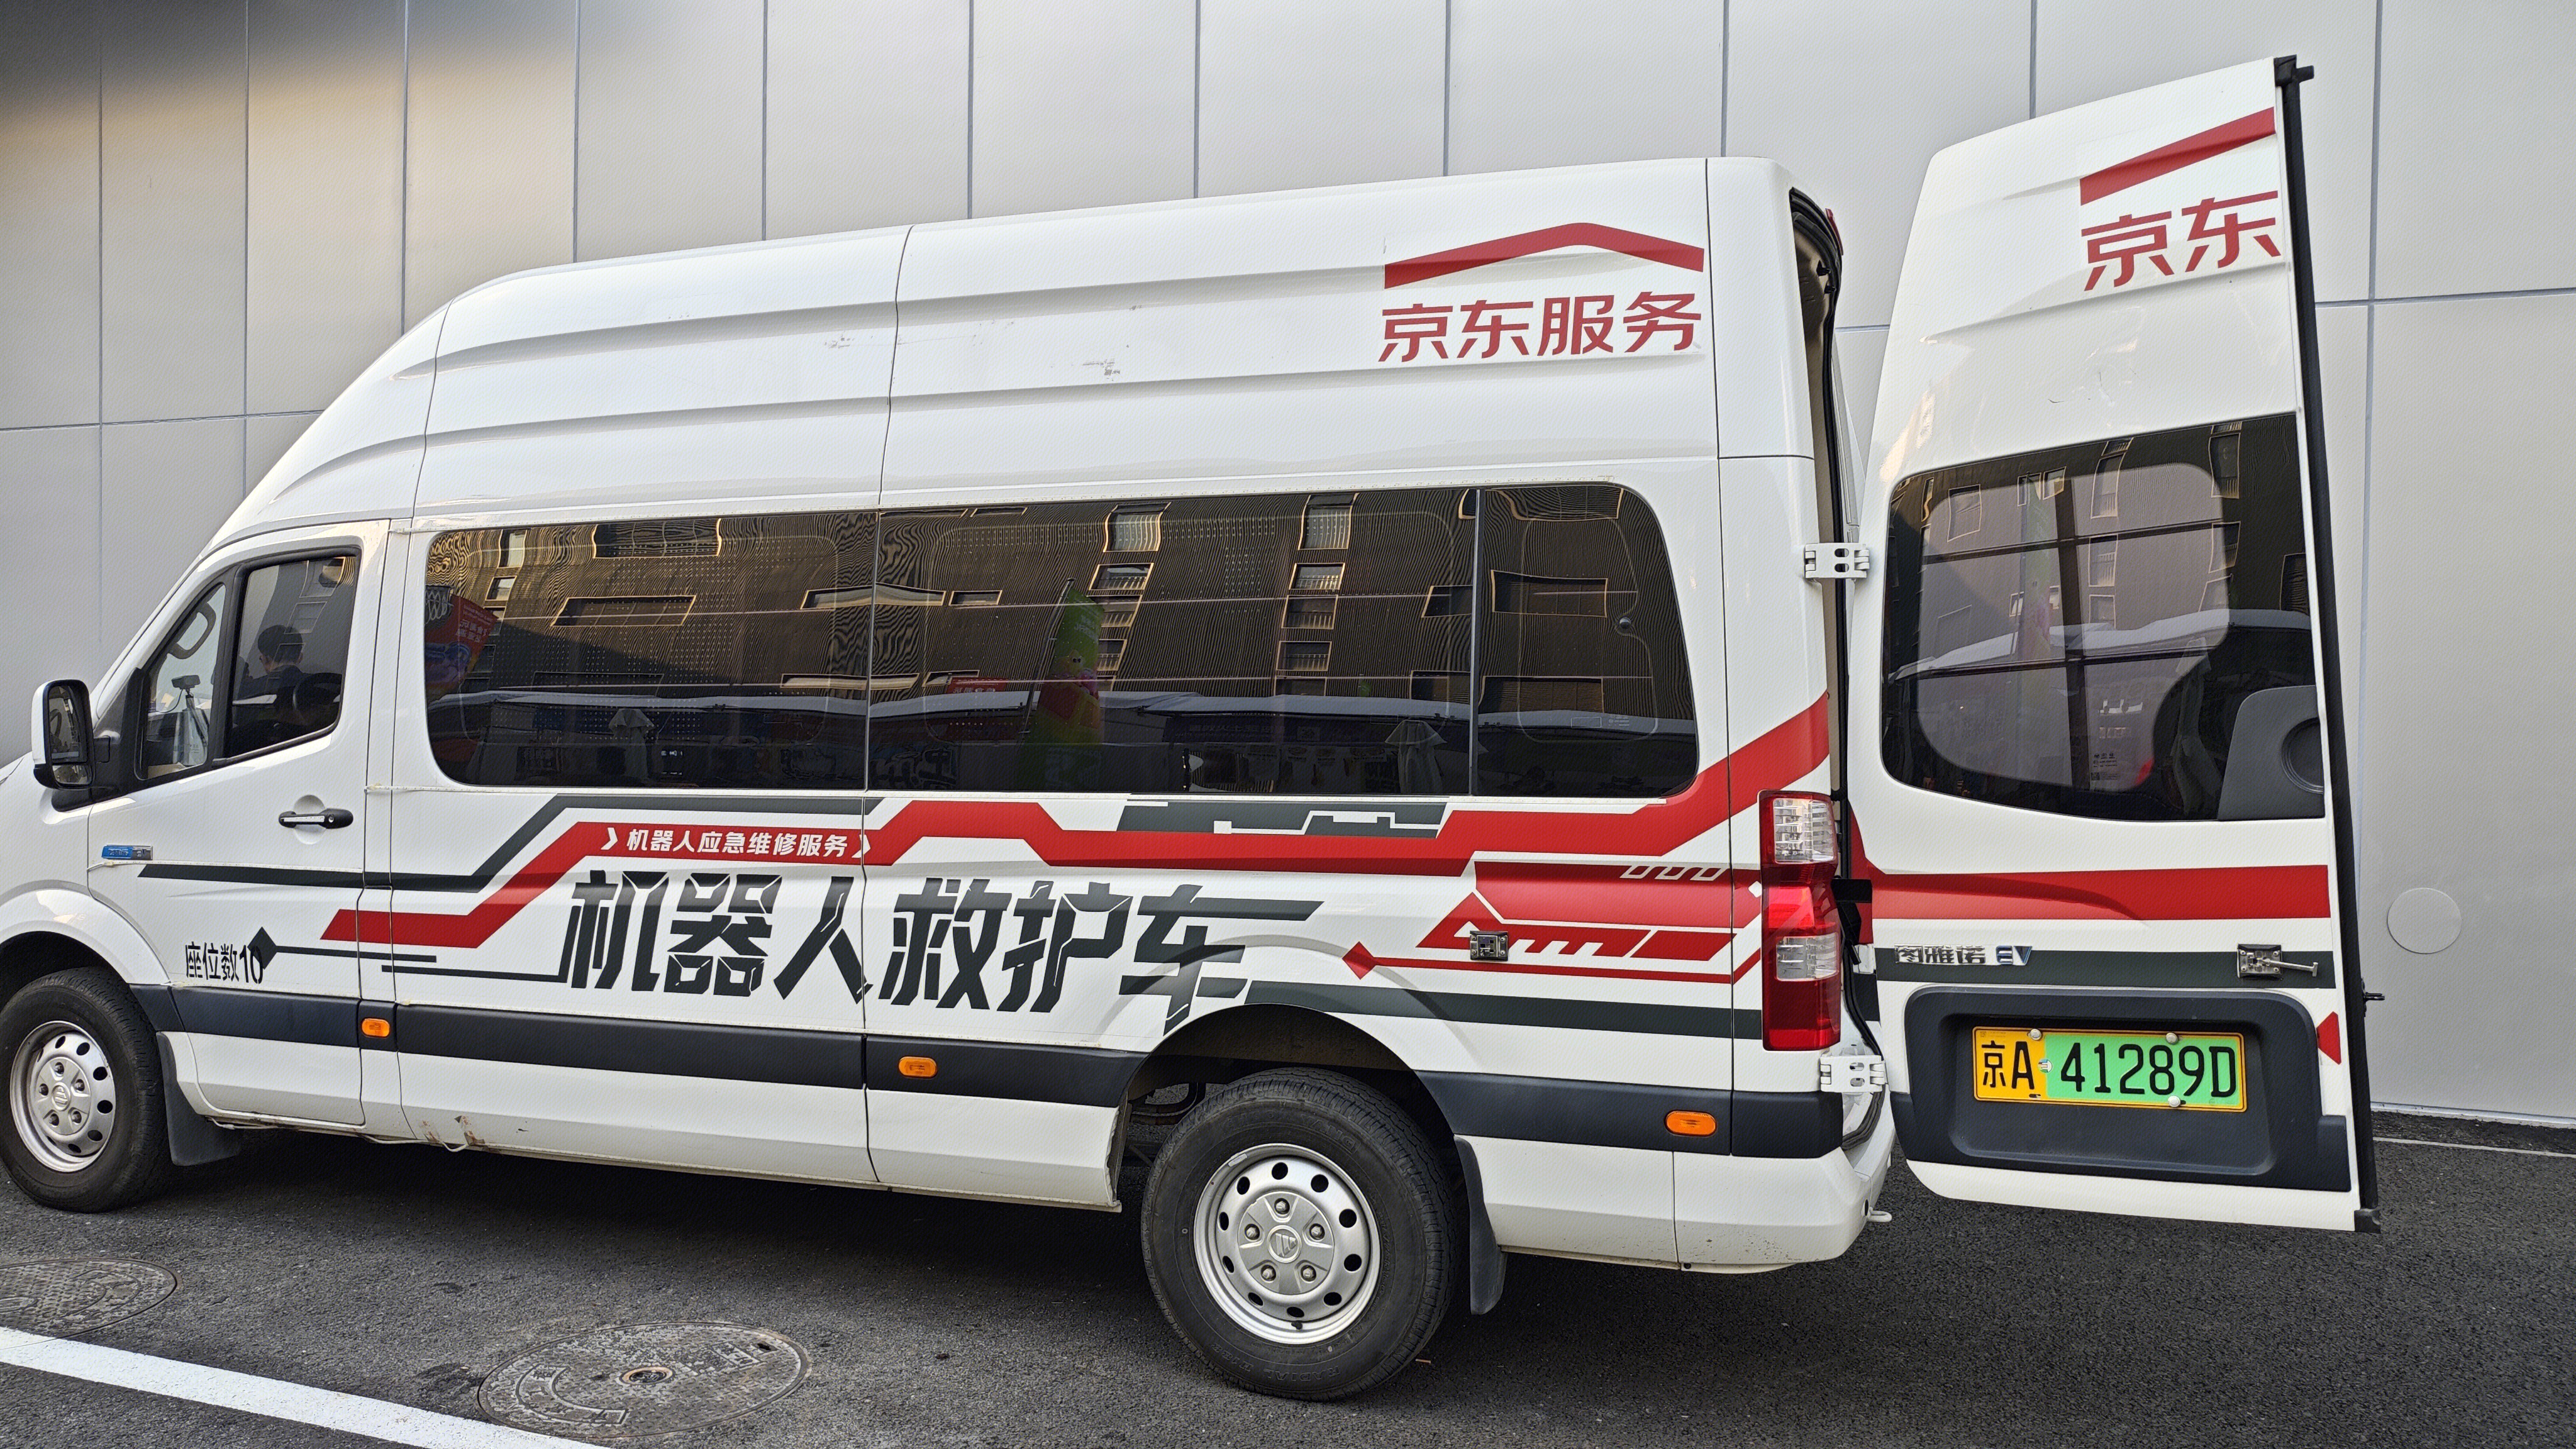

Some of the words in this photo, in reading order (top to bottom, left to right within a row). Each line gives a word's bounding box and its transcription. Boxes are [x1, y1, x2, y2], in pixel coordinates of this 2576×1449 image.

[2081, 190, 2281, 291] 京东
[1379, 291, 1701, 362] 京东服务
[627, 828, 848, 858] 机器人应急维修服务
[185, 941, 263, 984] 座位数10
[572, 870, 1248, 1036] 机器人救护车
[1894, 945, 1985, 964] 图雅诺
[1996, 945, 2033, 965] EV
[1263, 1366, 1340, 1381] RADIAL
